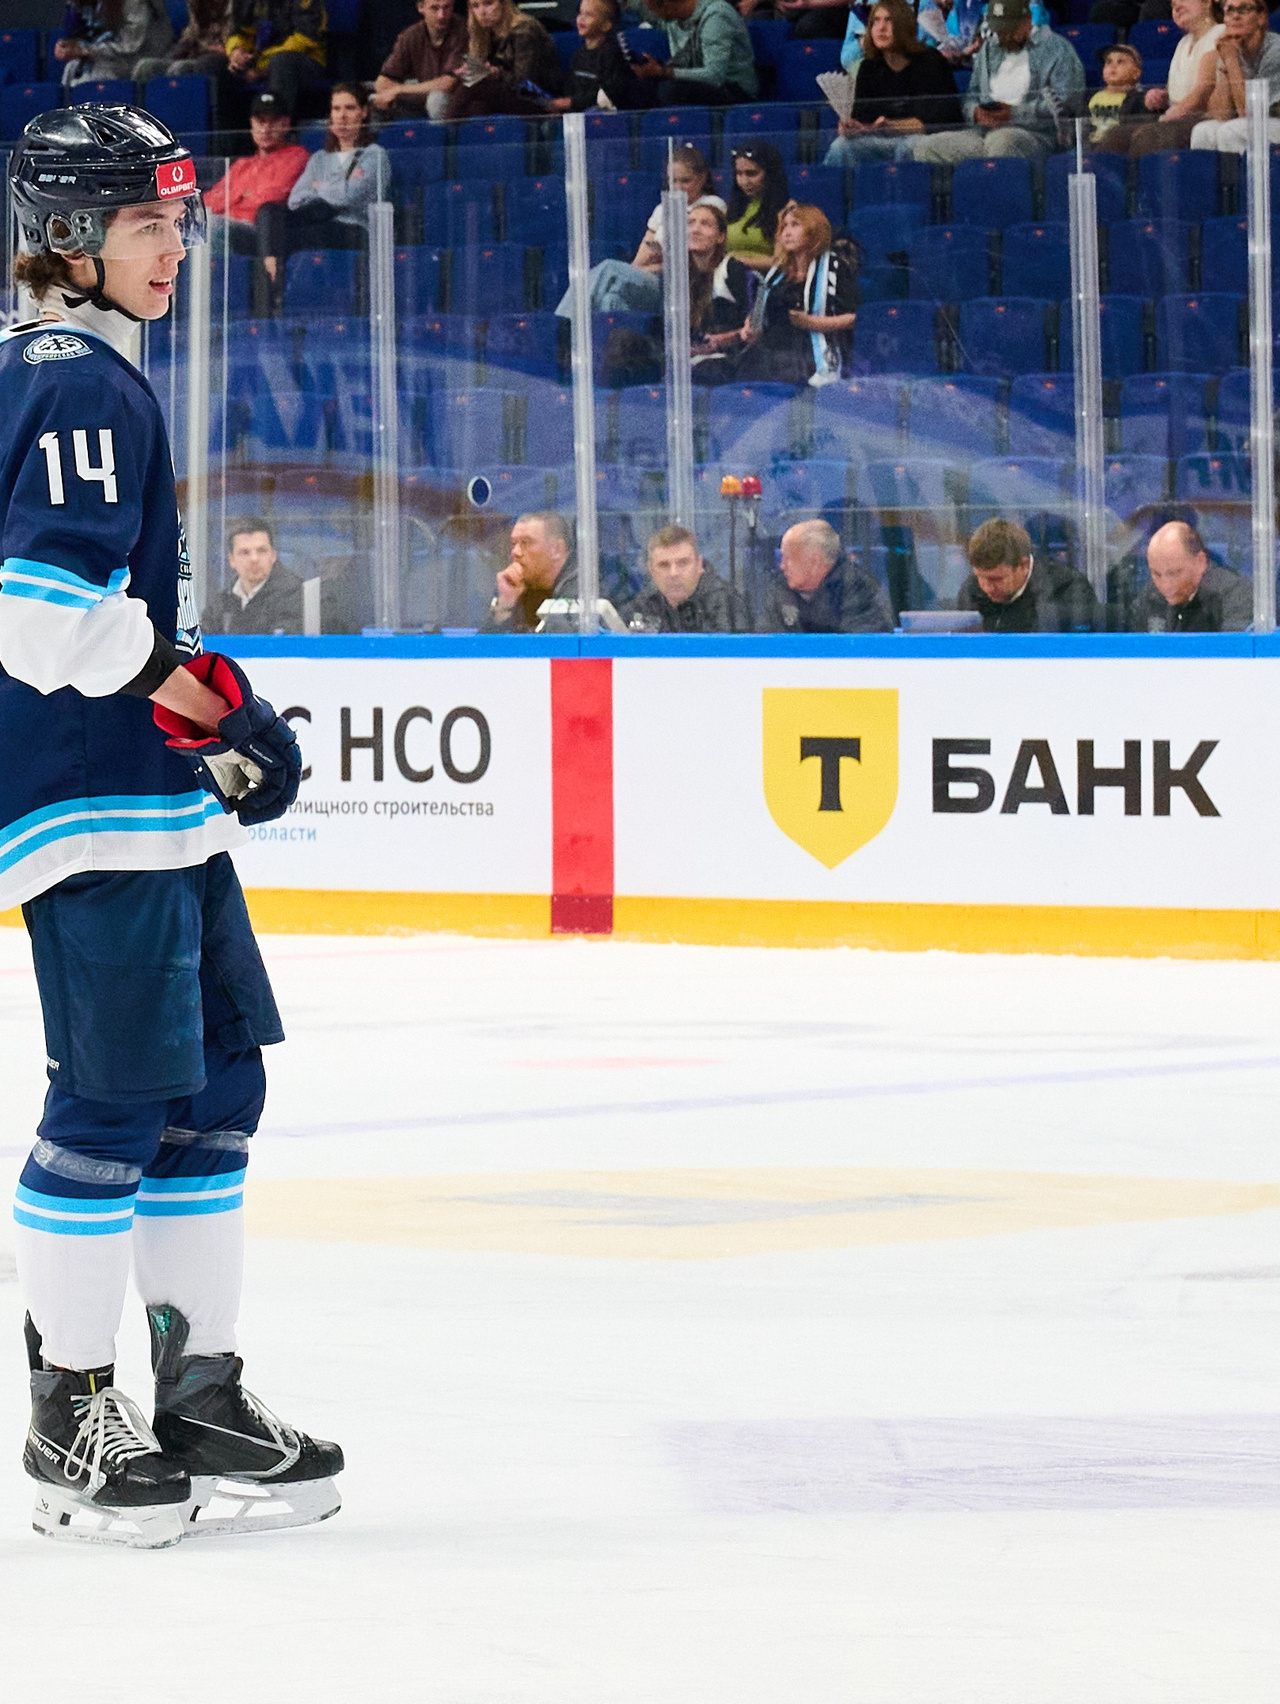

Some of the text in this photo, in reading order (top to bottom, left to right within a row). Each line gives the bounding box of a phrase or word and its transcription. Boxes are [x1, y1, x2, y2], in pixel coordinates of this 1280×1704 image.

[160, 181, 194, 196] OLIMPBET
[39, 428, 118, 505] 14
[340, 706, 491, 784] НСО
[799, 736, 1223, 818] Т БАНК
[373, 800, 494, 819] строительства
